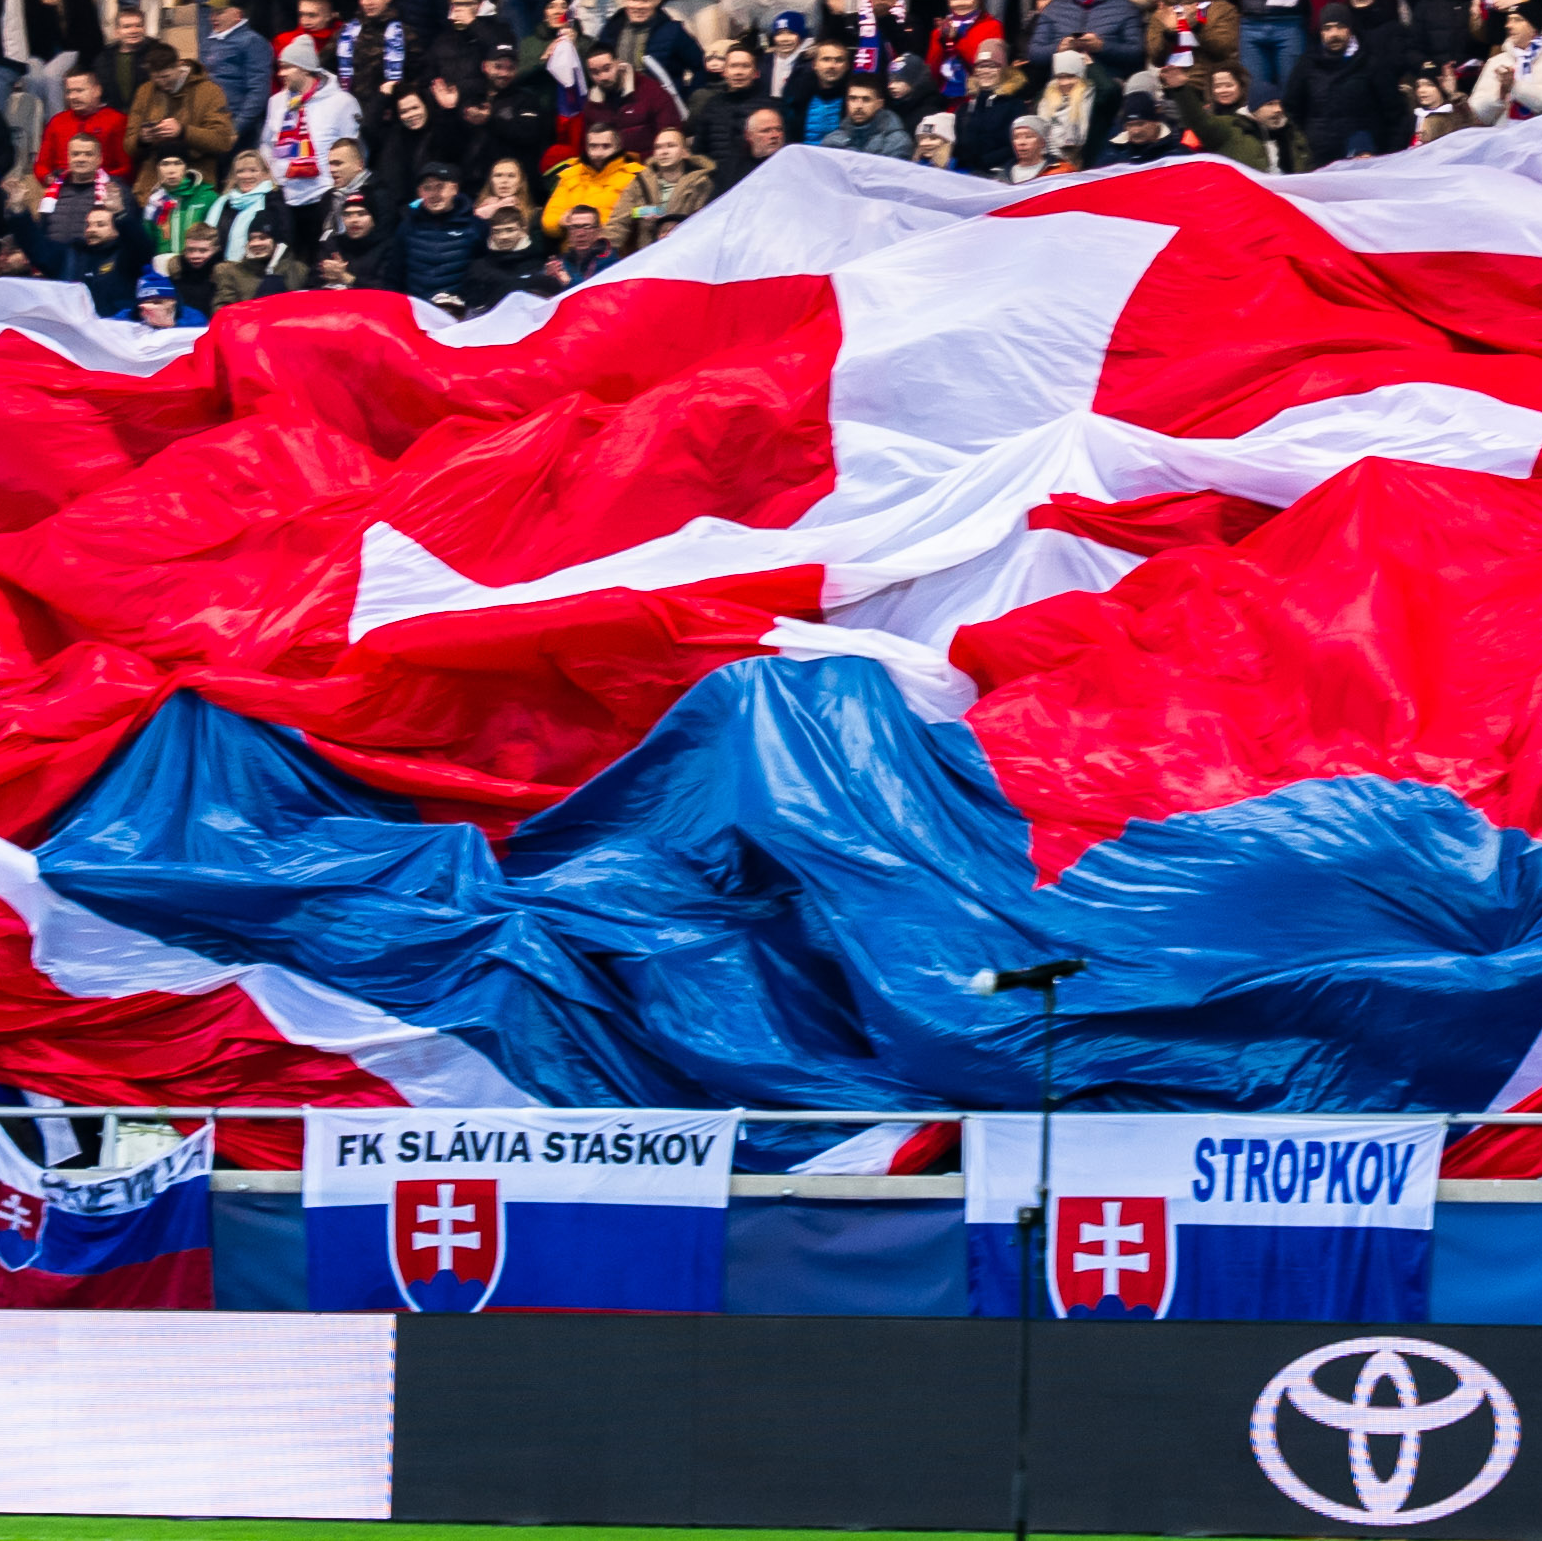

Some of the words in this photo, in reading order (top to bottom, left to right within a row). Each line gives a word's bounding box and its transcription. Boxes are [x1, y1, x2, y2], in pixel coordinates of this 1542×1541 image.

[336, 1133, 385, 1167] FK
[396, 1121, 532, 1164] SLÁVIA
[540, 1122, 716, 1167] STAŠKOV
[1192, 1137, 1416, 1205] STROPKOV
